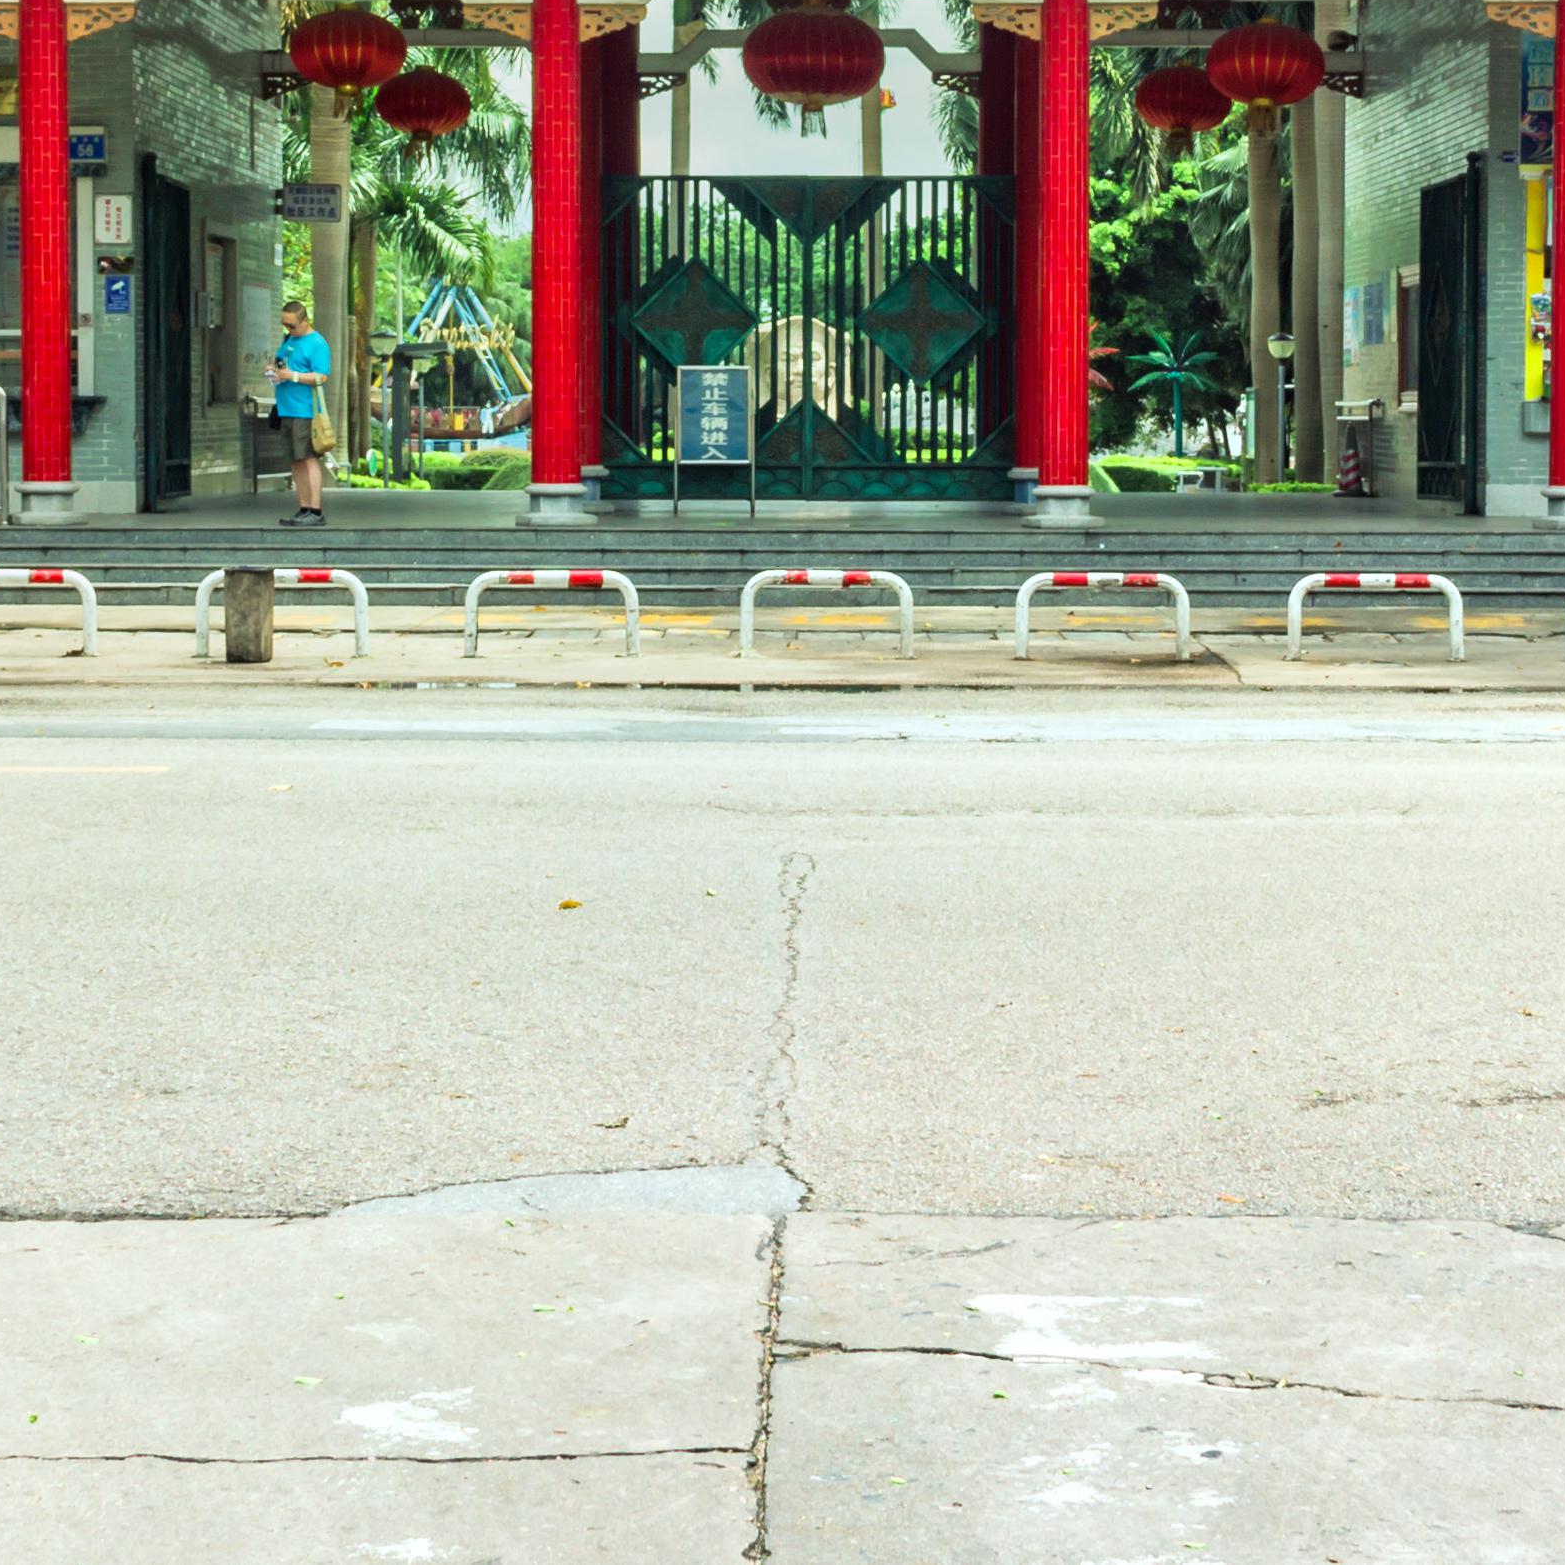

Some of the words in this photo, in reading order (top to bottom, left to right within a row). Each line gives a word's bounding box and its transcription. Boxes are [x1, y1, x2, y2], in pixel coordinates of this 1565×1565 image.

[77, 143, 94, 157] 56
[700, 372, 729, 460] 禁止车辆进入
